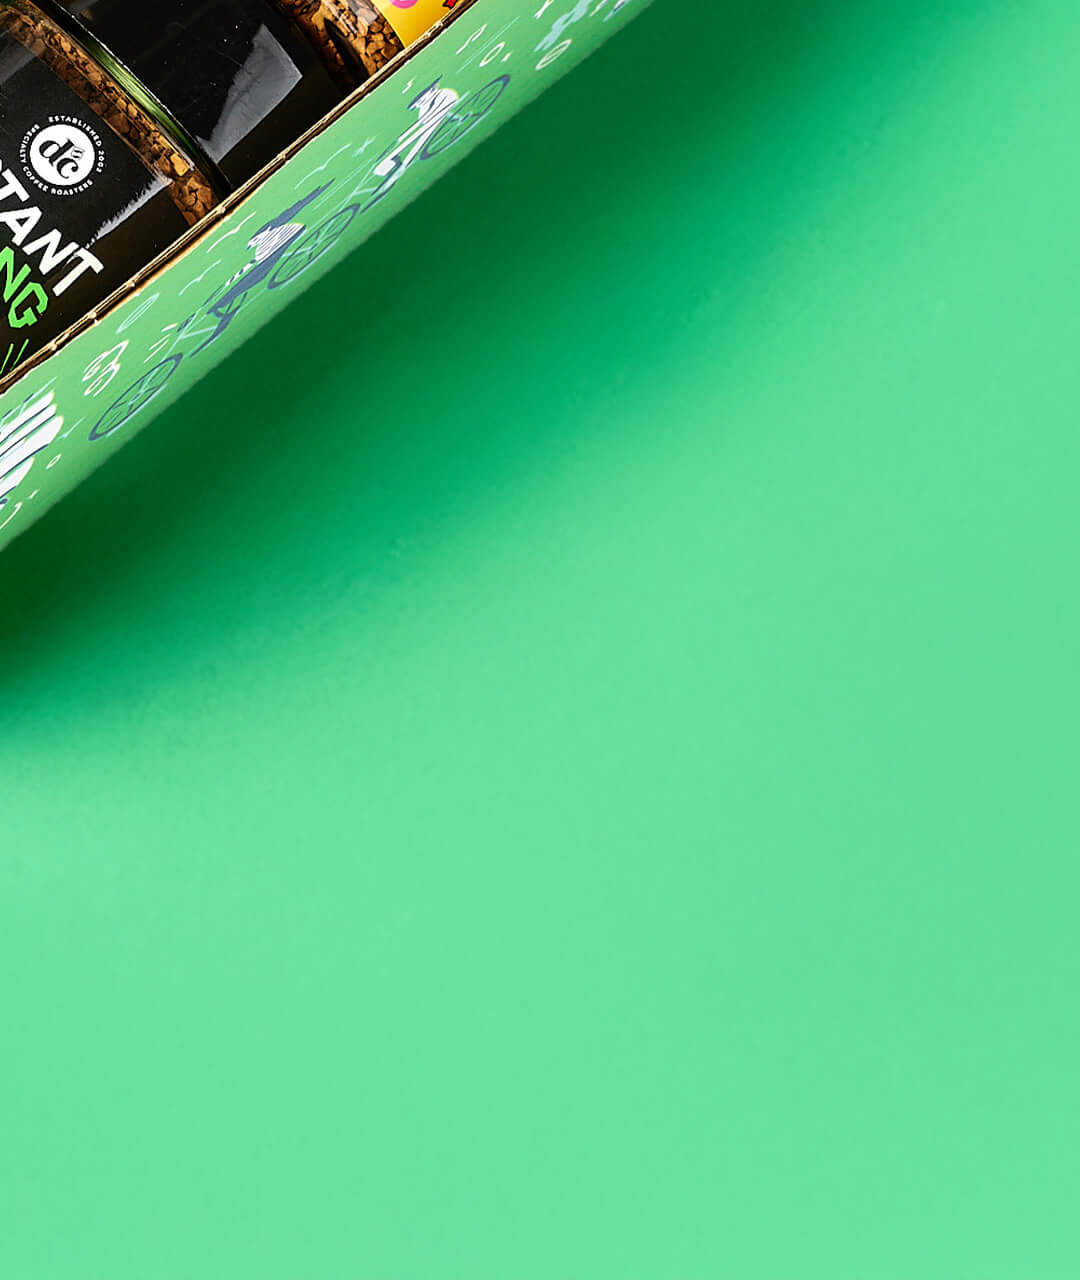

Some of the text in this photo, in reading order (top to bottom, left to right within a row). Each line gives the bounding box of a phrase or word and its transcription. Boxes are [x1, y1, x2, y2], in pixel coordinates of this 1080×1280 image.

[48, 115, 102, 147] ESTABLISHED
[19, 123, 93, 195] SPECIALTY COFFEE ROASTERS
